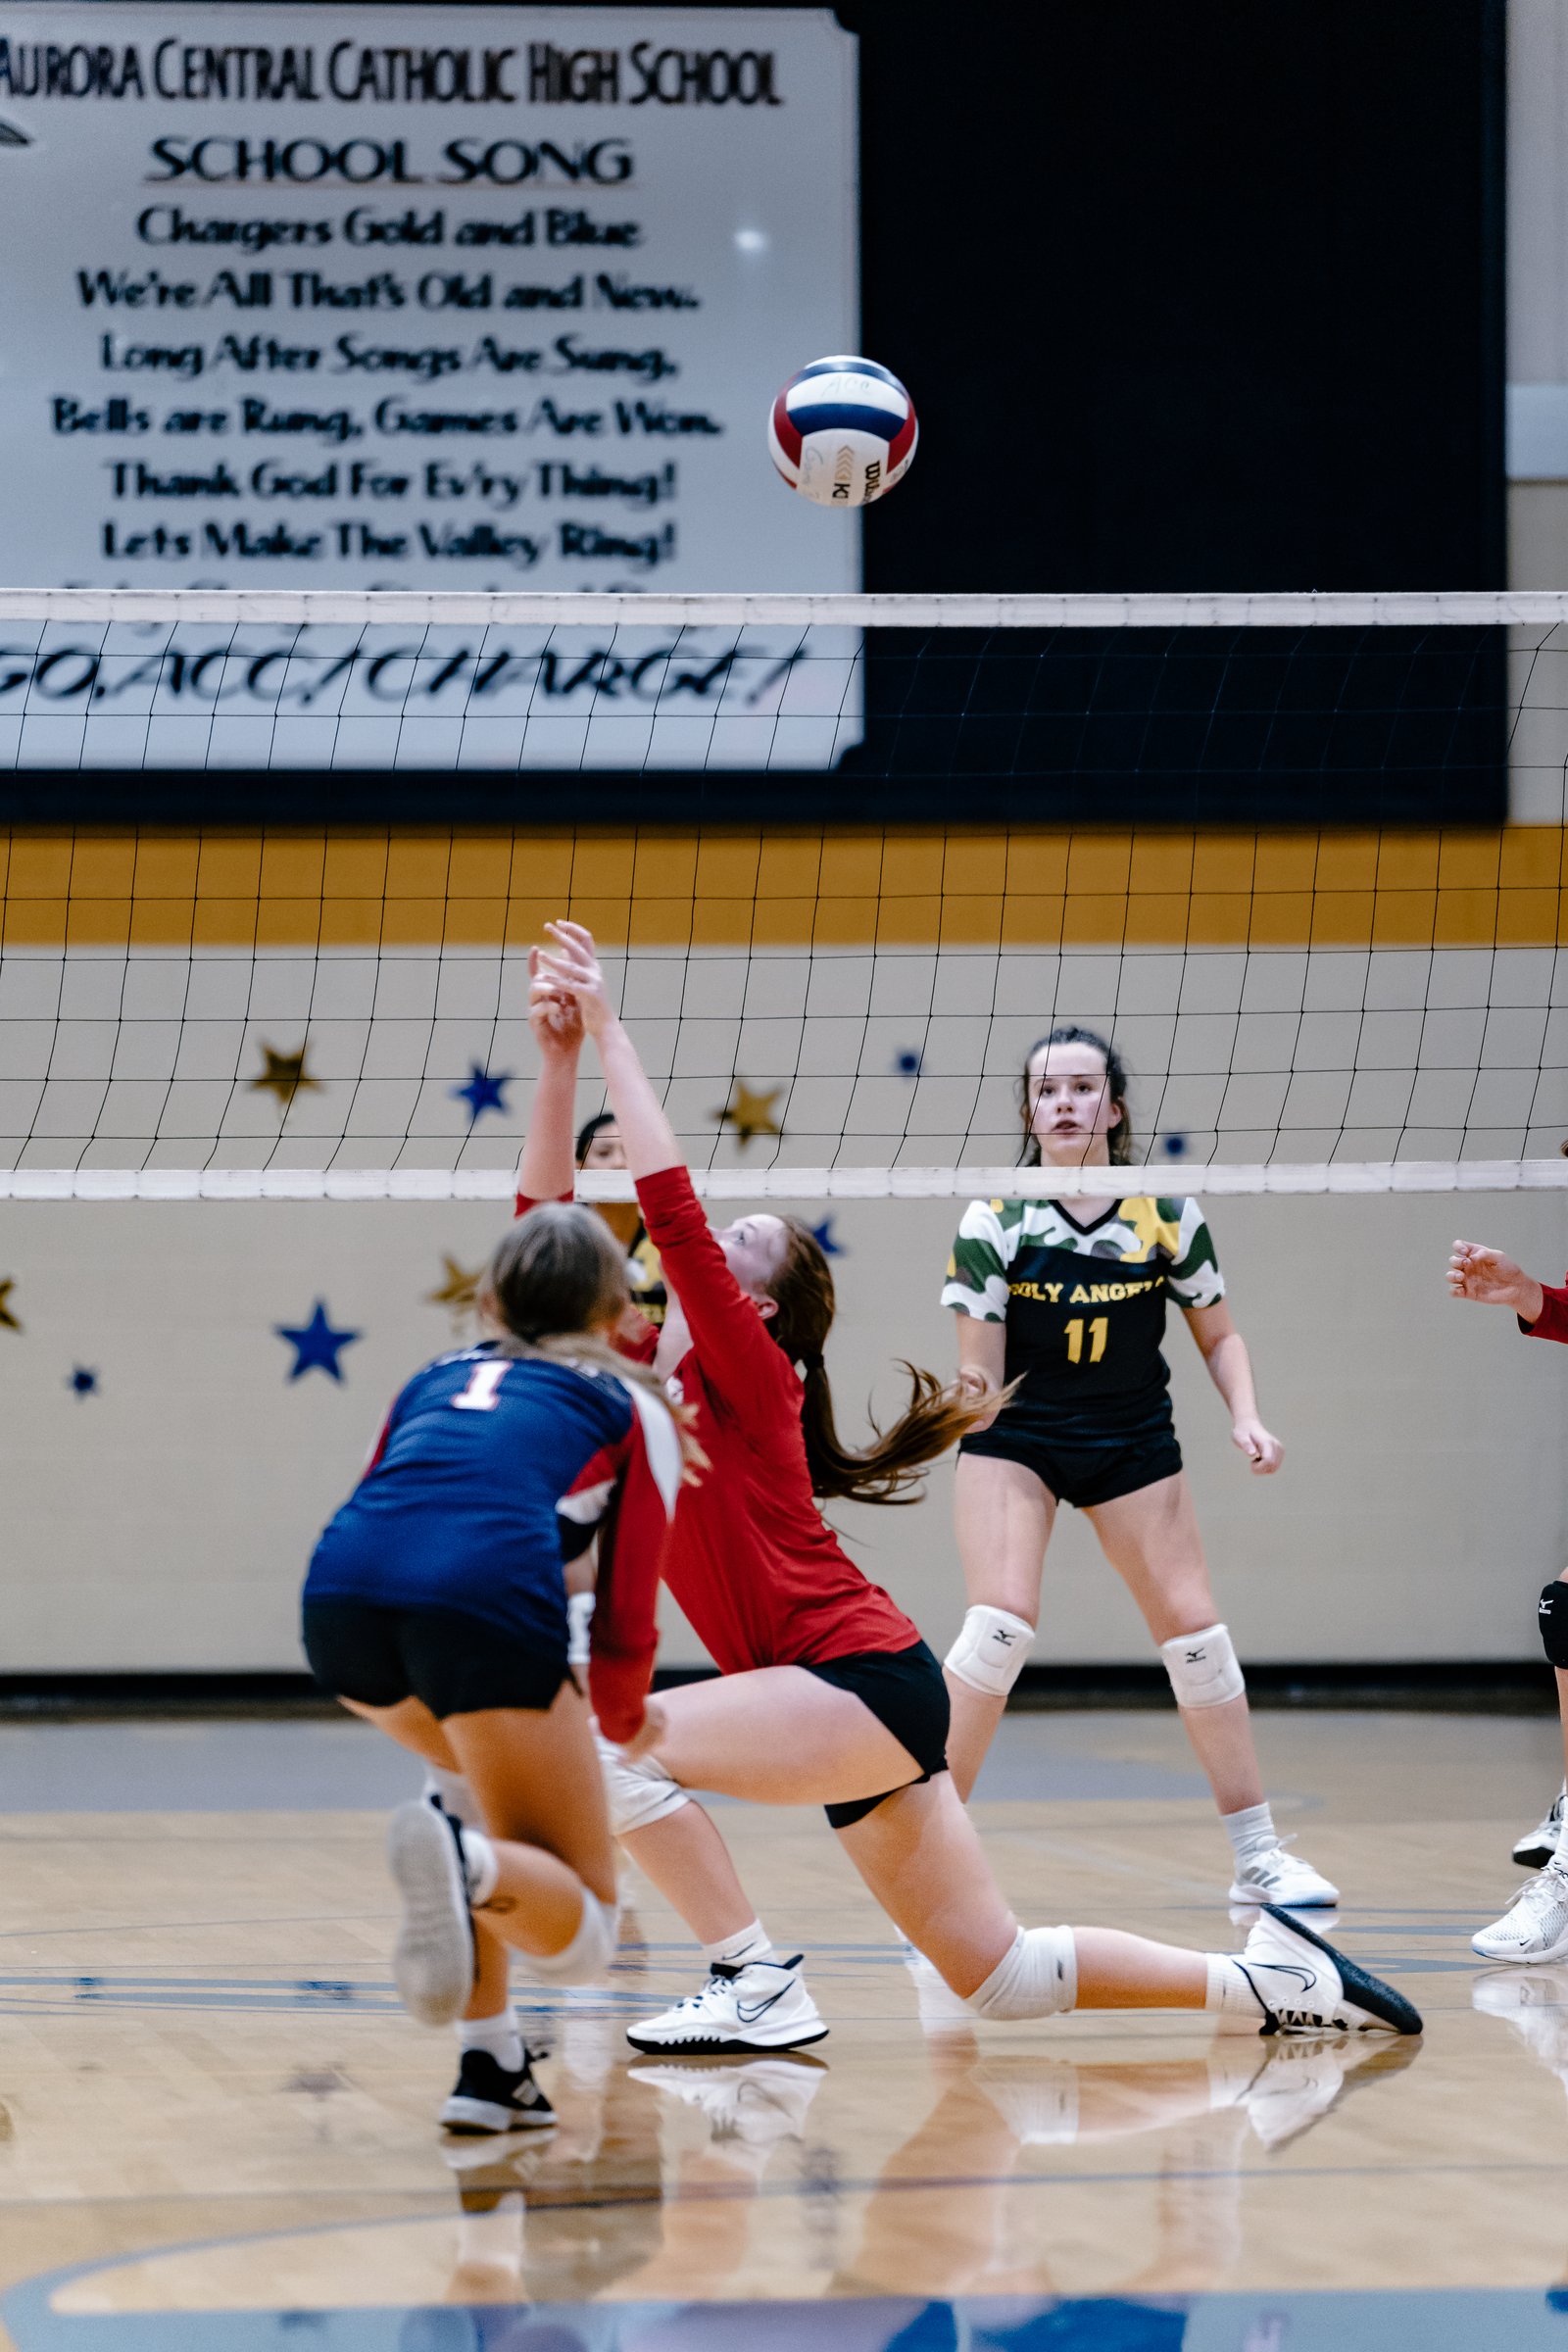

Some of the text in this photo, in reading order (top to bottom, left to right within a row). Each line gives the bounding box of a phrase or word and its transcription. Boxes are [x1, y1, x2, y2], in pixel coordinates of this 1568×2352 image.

[151, 36, 322, 103] CENTRAL
[325, 38, 517, 105] CATHOLIC
[526, 41, 621, 105] HIGH
[627, 40, 784, 107] SCHOOL
[145, 136, 634, 184] SCHOOL SONG
[135, 205, 641, 255] Chargers Gold and Blue
[75, 268, 197, 309] We're
[202, 269, 274, 309] All
[285, 270, 408, 311] That's
[416, 271, 494, 311] Old
[502, 273, 585, 311] and
[100, 331, 206, 380] Long
[210, 333, 322, 372] After
[334, 333, 464, 384] Songs
[466, 335, 544, 374] Are
[50, 395, 153, 436] Bells
[162, 409, 230, 436] are
[372, 396, 520, 437] Games
[525, 396, 605, 438] Are
[106, 460, 243, 500] Thank
[248, 460, 340, 501] God
[347, 460, 412, 500] For
[534, 460, 677, 510] Thing!
[101, 519, 677, 572] Lets Make The Valley Ring!
[1069, 1276, 1164, 1303] ANGE
[1063, 1317, 1108, 1364] 11
[452, 1359, 514, 1411] 1
